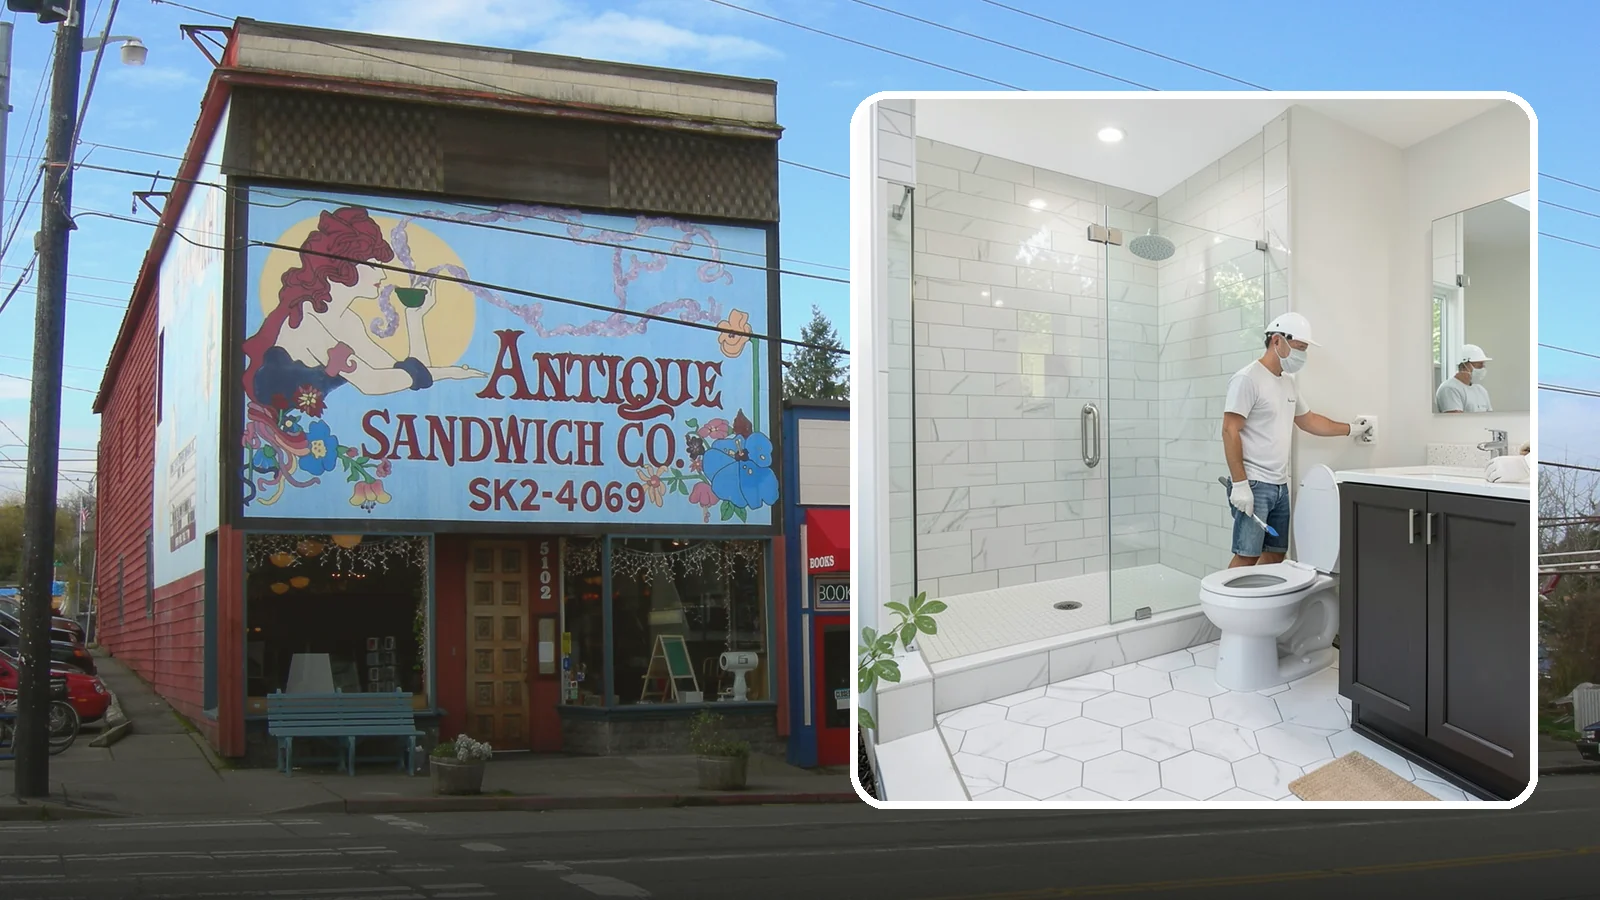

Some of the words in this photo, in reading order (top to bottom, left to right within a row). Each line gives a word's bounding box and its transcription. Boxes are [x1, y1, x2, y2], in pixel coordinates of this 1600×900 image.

[361, 408, 604, 467] SANDWICH
[616, 422, 684, 469] CO.
[468, 477, 645, 513] SK2-4069
[540, 541, 552, 600] 5102
[809, 555, 834, 568] BOOKS
